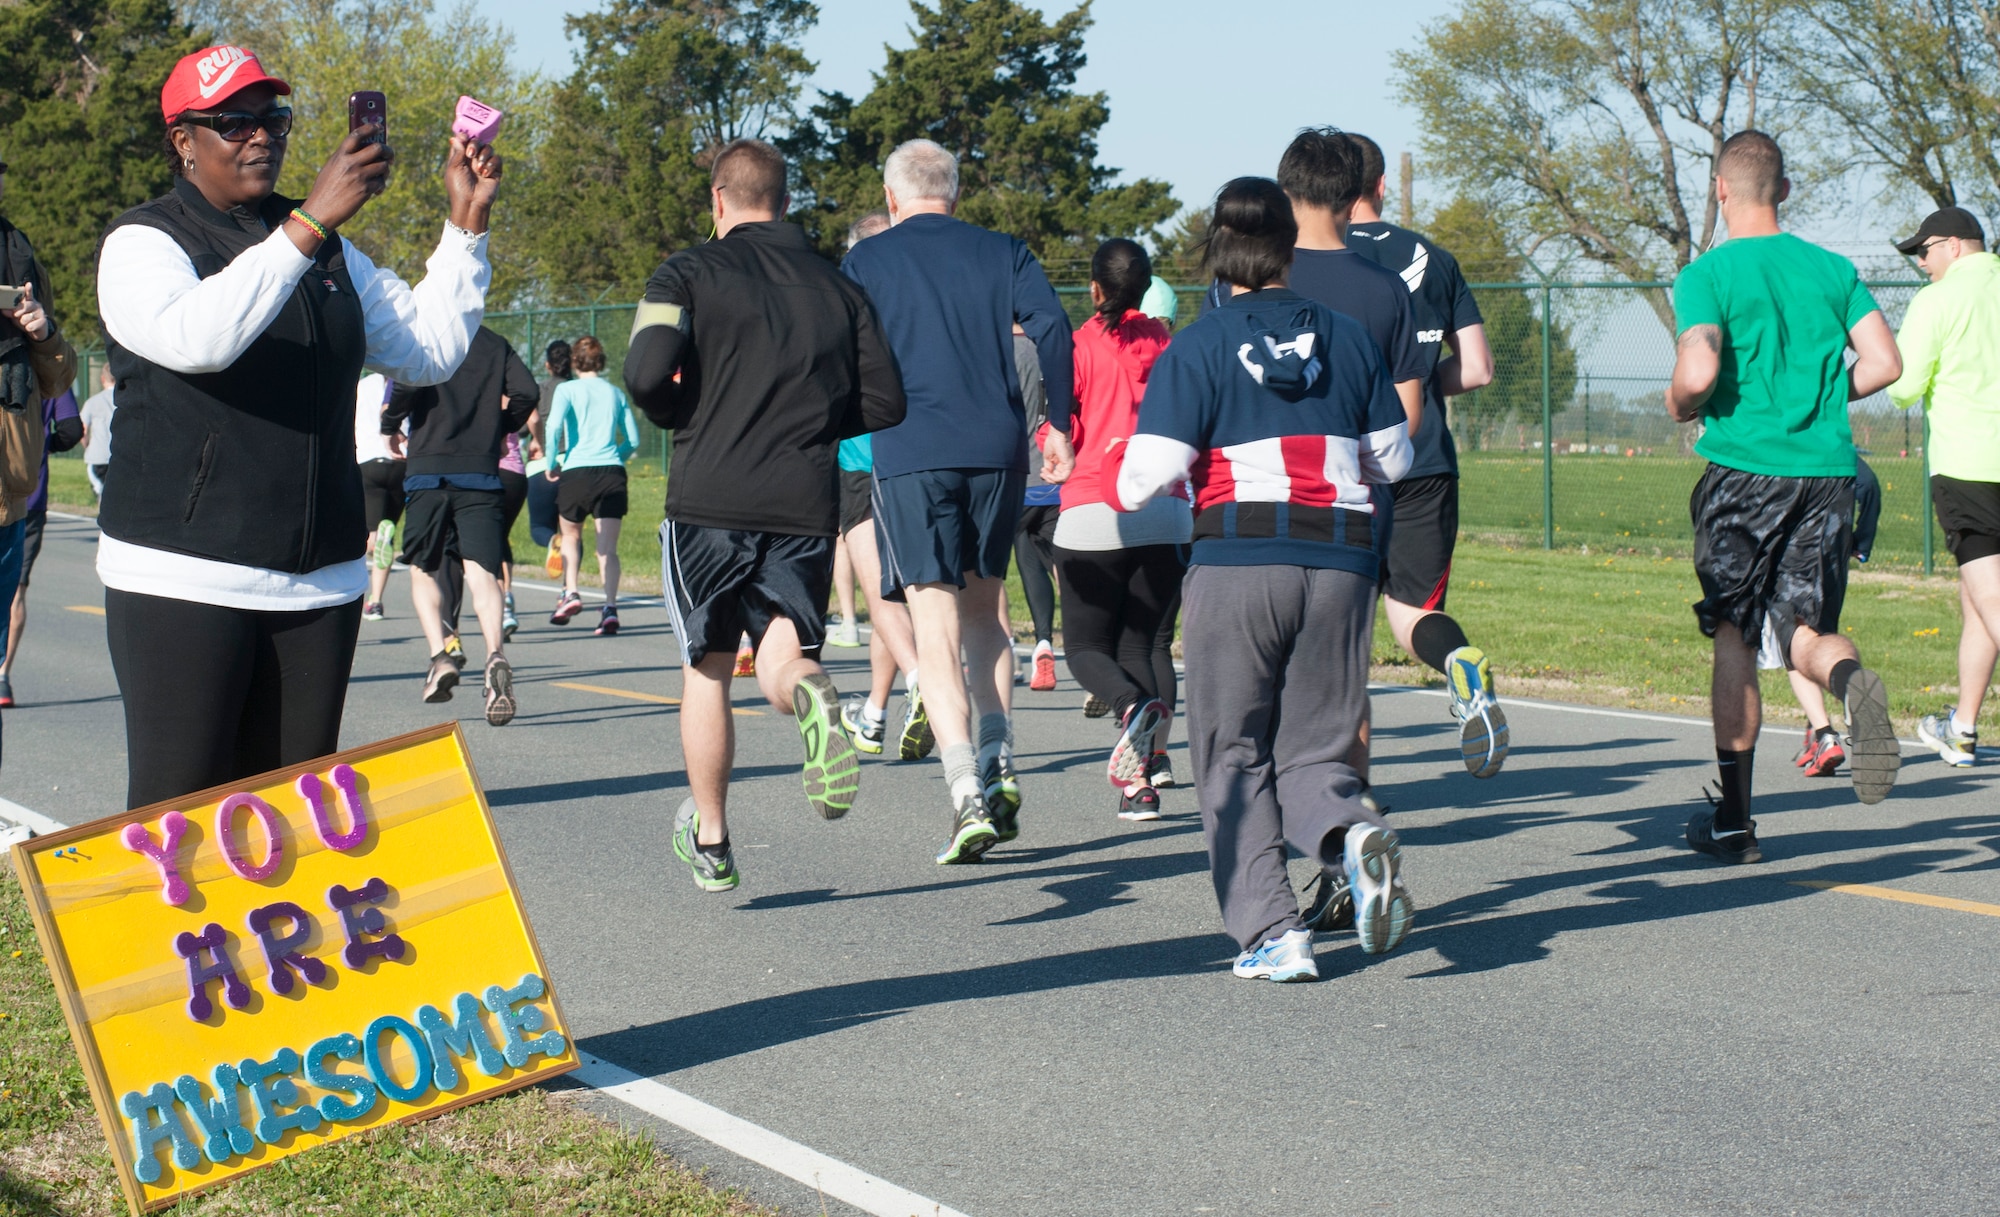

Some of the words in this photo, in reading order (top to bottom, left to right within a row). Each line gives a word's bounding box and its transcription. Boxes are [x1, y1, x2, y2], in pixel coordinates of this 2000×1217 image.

[196, 46, 246, 84] RUN
[1416, 329, 1444, 344] RCE
[120, 763, 368, 907] YOU
[173, 877, 405, 1022] ARE
[120, 973, 566, 1184] AWESOME
